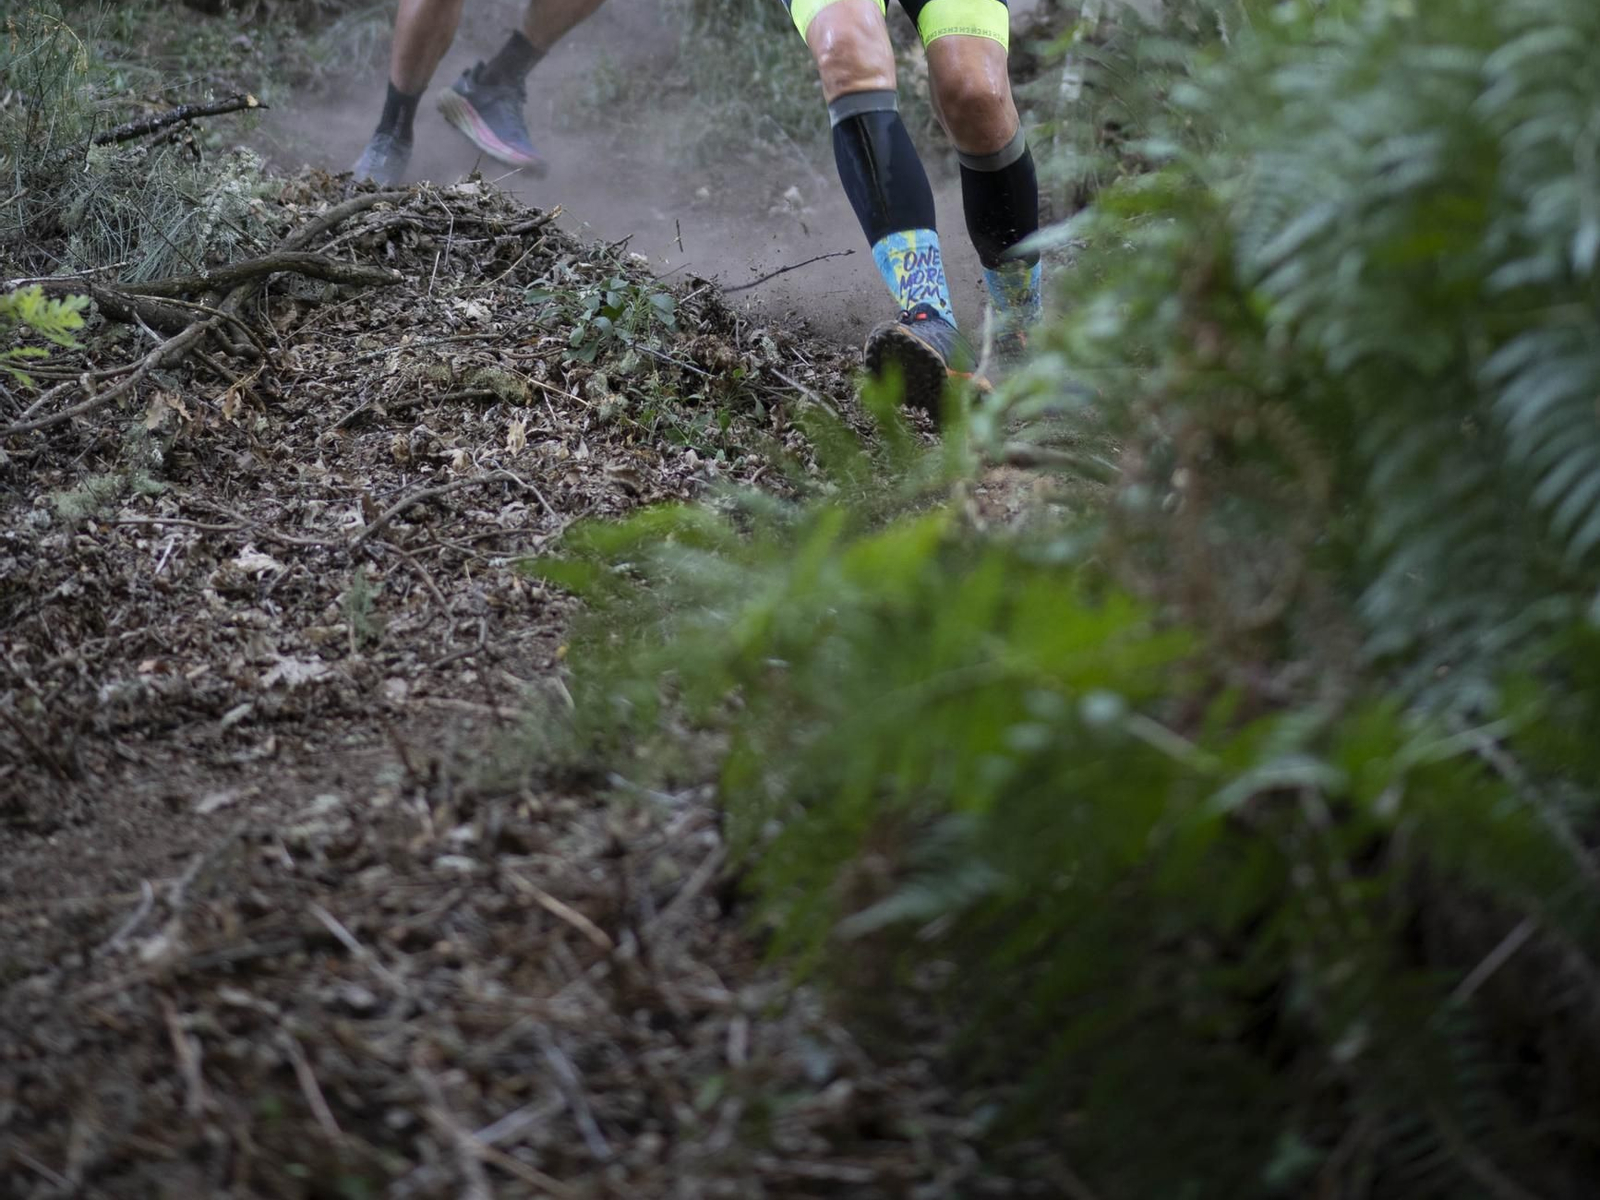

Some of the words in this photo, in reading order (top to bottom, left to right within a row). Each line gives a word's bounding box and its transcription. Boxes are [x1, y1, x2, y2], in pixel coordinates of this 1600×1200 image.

[903, 244, 940, 272] ONE
[900, 268, 945, 299] MORE
[906, 285, 941, 309] KM
